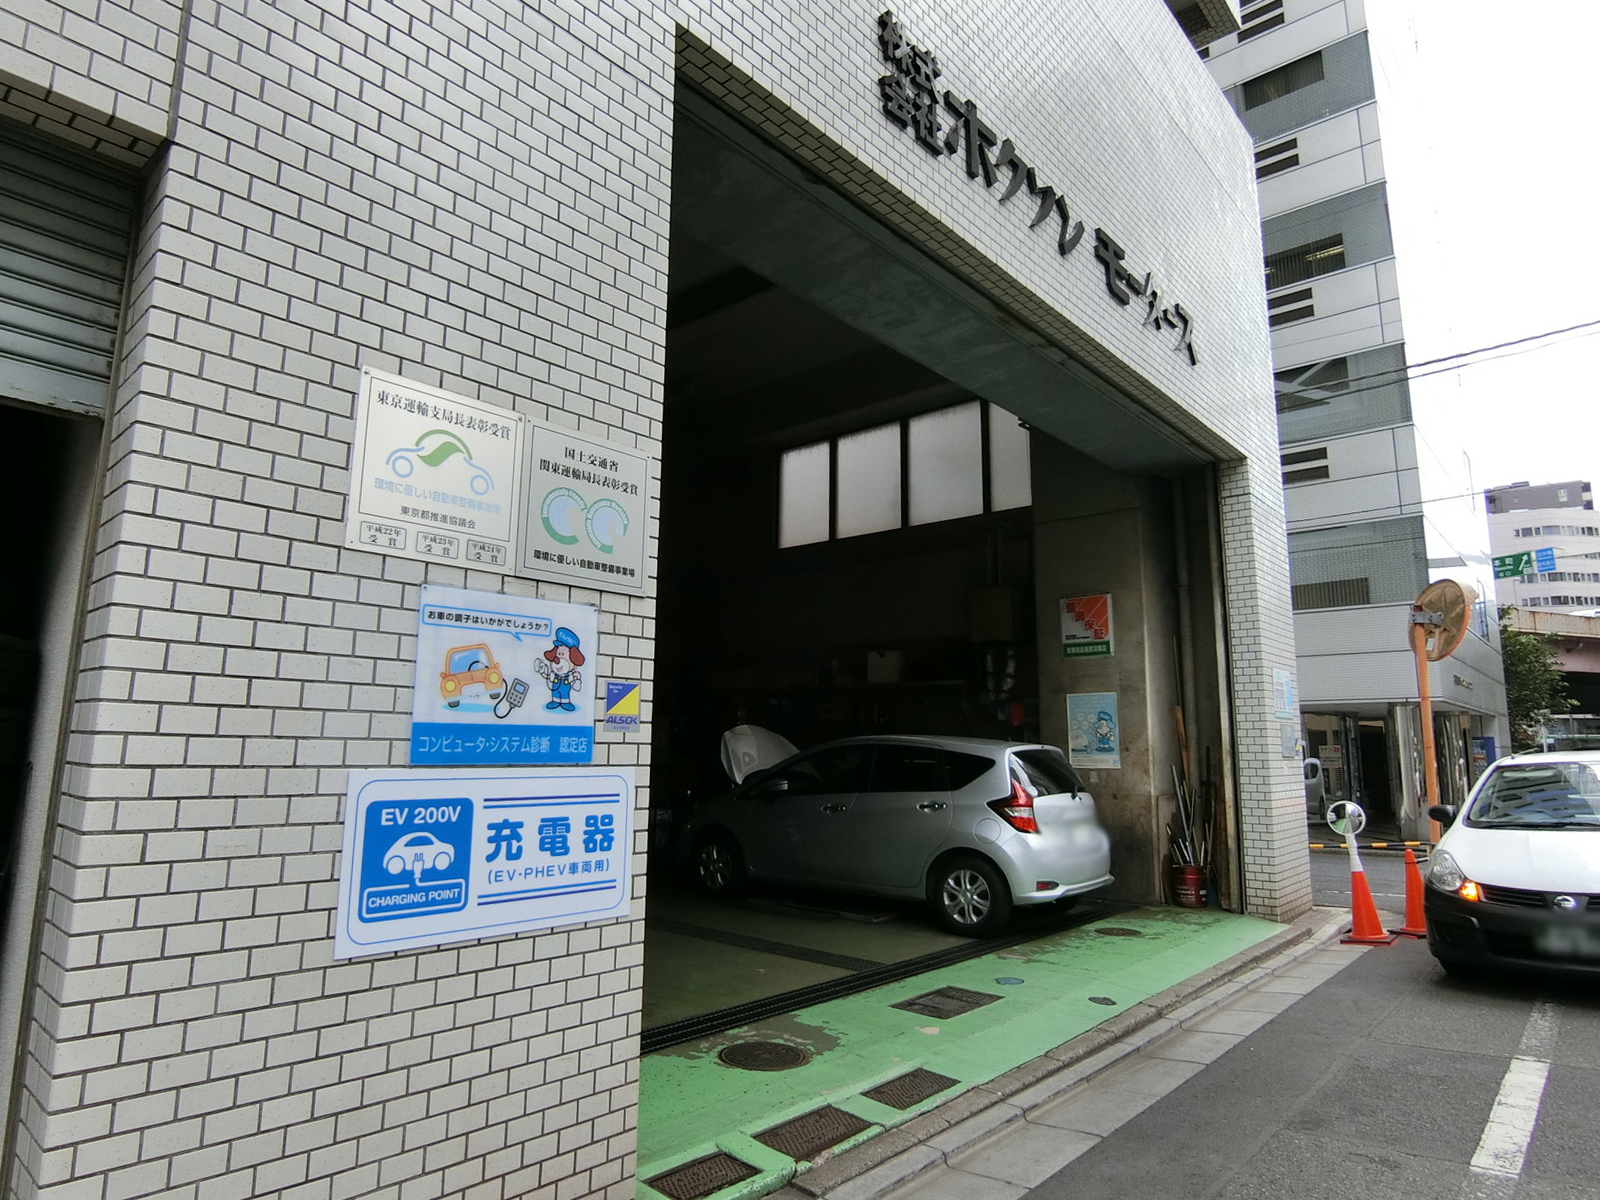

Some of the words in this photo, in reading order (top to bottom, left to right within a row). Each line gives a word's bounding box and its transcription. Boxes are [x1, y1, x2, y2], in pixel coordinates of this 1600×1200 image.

[377, 390, 512, 441] 東京運輸支局長表彰受賞
[564, 446, 619, 473] 国土交通省
[539, 458, 639, 496] 関東運輸局長表彰受賞
[400, 505, 476, 530] 東京都推進協議会
[366, 524, 402, 538] 平成22年
[422, 534, 455, 548] 平成23年
[606, 715, 638, 725] ALSOK
[559, 736, 588, 754] 認定店
[381, 807, 408, 826] EV
[413, 805, 461, 825] 200V
[485, 813, 615, 863] 充電器
[368, 891, 426, 909] CHARGING
[428, 887, 461, 903] POINT
